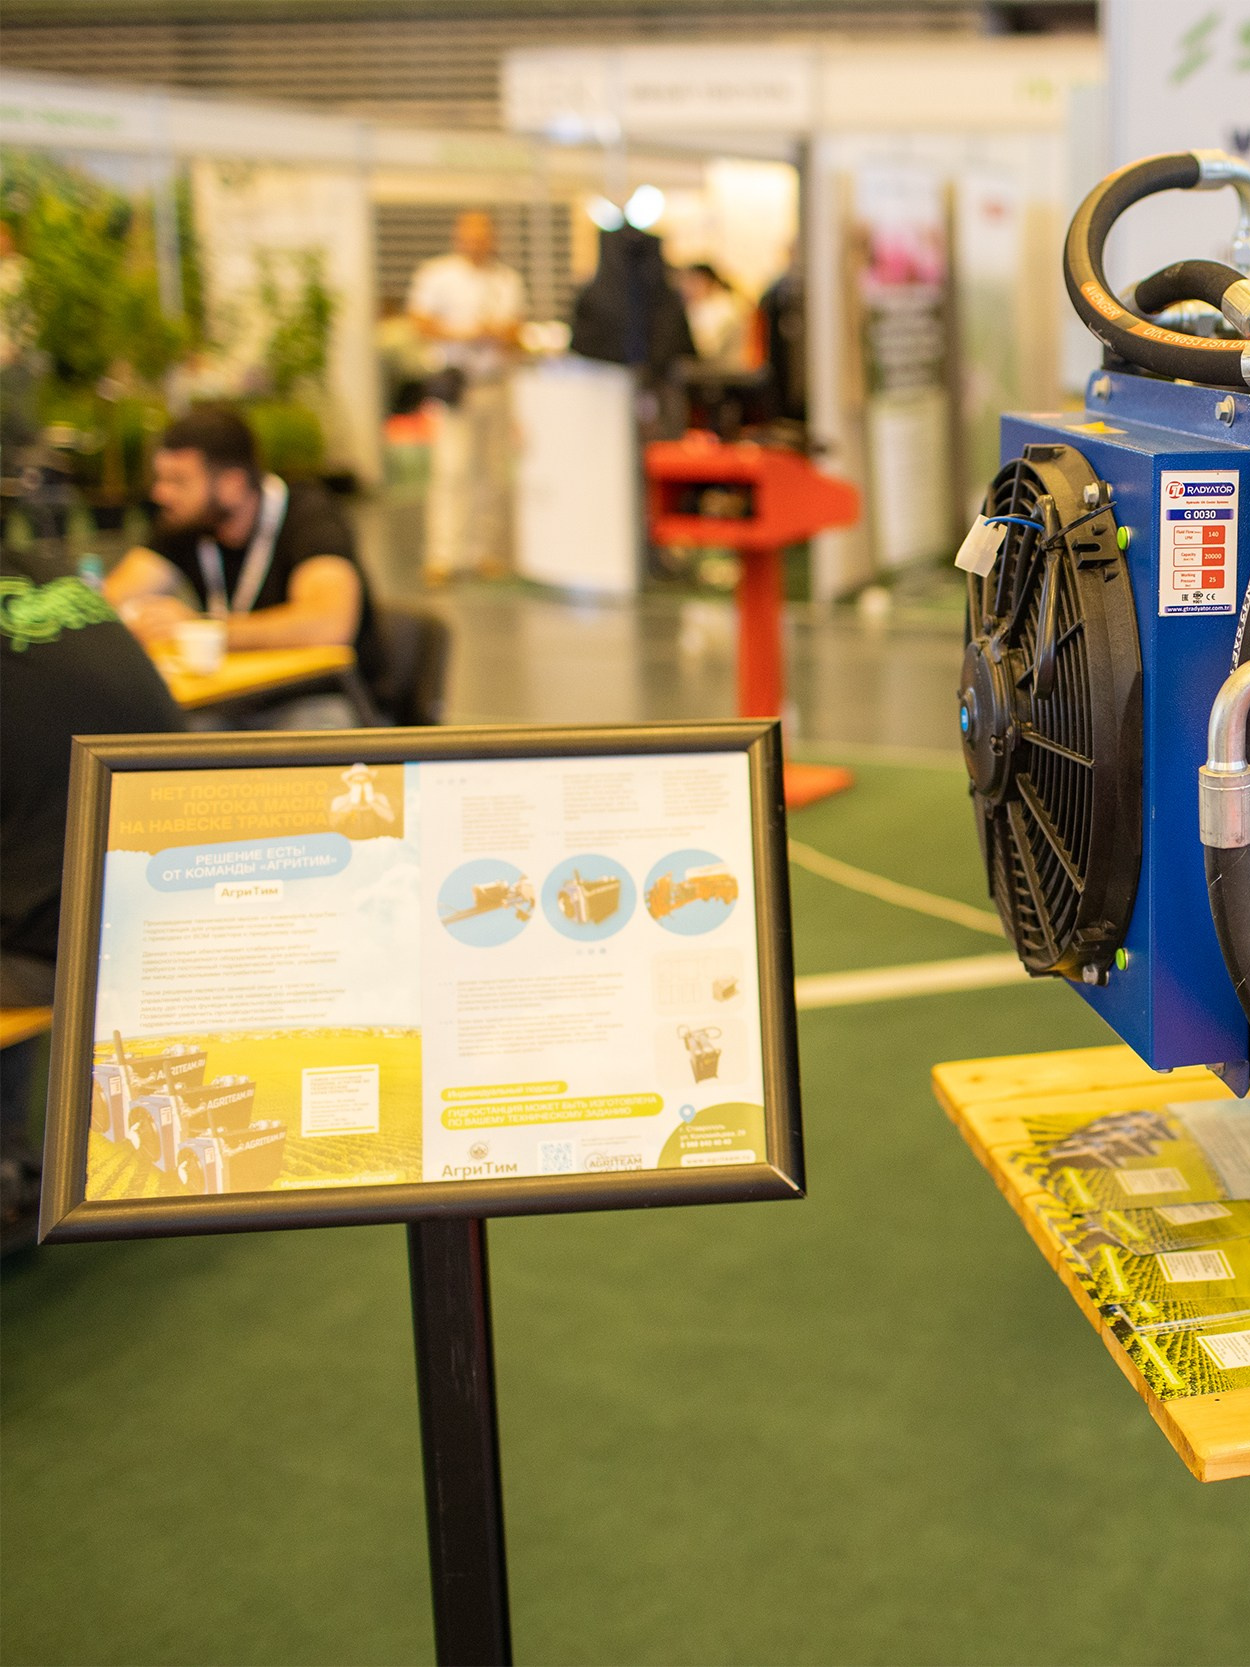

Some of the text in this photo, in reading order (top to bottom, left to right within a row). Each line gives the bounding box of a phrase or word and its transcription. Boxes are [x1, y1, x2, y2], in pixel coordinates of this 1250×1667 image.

[1085, 286, 1121, 317] AVENGER
[1202, 339, 1228, 348] 2SN
[1184, 510, 1216, 519] G 0030
[151, 780, 329, 801] НЕТ ПОСТОЯННОГО
[184, 797, 328, 816] ПОТОКА МАСЛА
[120, 819, 145, 835] НА
[150, 815, 232, 833] НАВЕСКЕ
[195, 845, 306, 866] РЕШЕНИЕ ЕСТЬ!
[162, 869, 182, 882] ОТ
[185, 863, 256, 880] КОМАНДЫ
[221, 886, 279, 899] АгриТим
[448, 1103, 523, 1118] ГИДРОСТАНЦИЯ
[525, 1101, 560, 1113] МОЖЕТ
[448, 1117, 462, 1127] ПО
[464, 1114, 505, 1127] ВАШЕМУ
[442, 1161, 518, 1180] АгриТим
